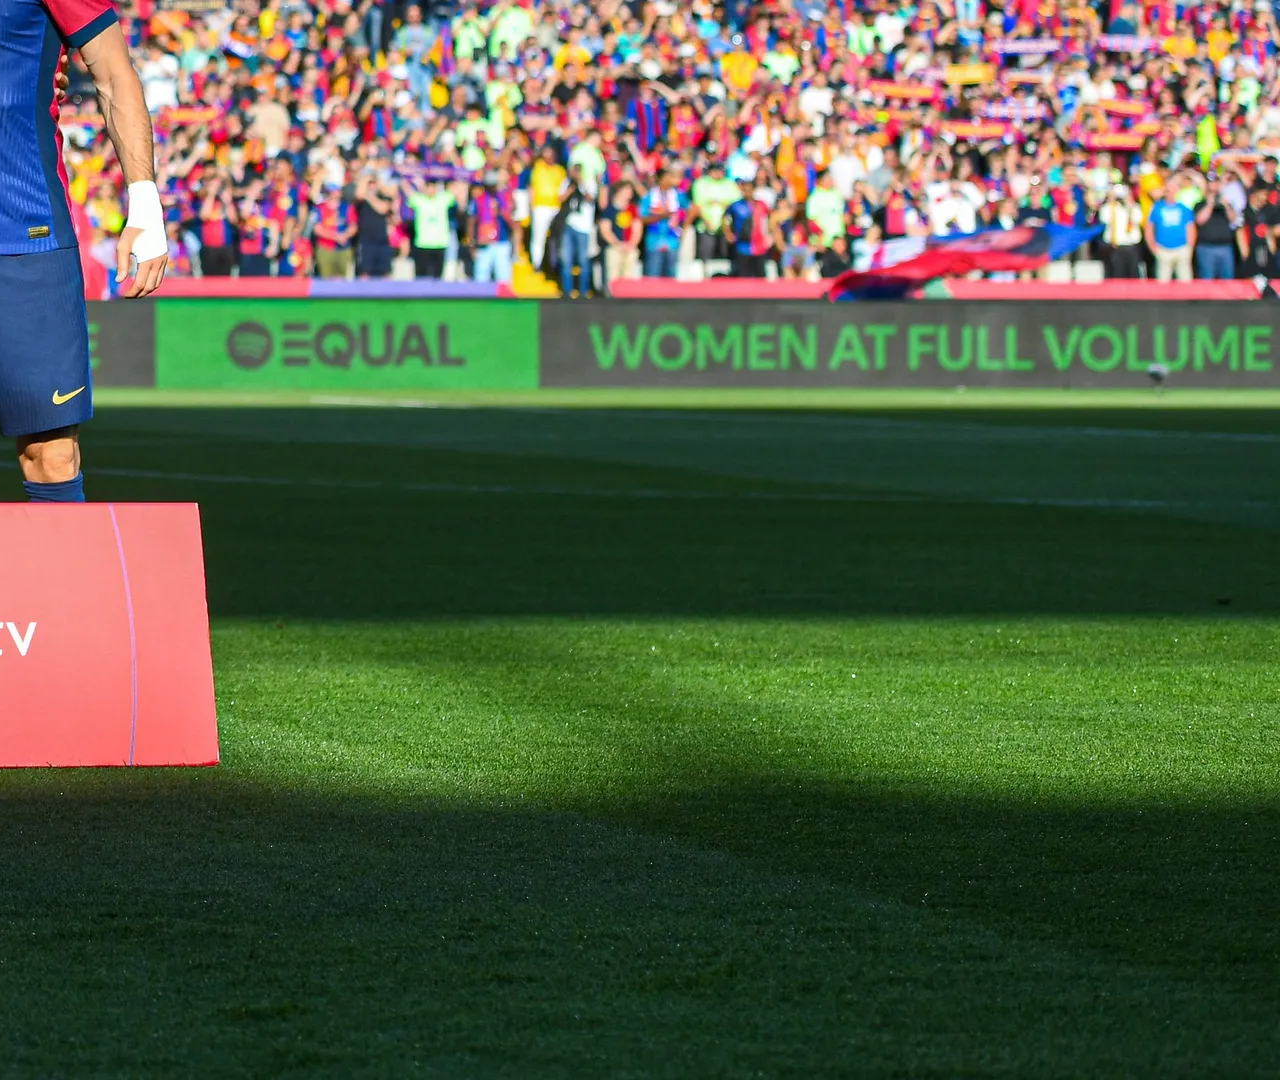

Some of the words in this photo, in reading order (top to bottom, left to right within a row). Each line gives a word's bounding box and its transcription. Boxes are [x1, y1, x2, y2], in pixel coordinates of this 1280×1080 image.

[282, 321, 468, 369] EQUAL
[588, 322, 819, 372] WOMEN
[827, 323, 898, 373] AT
[906, 323, 1036, 373] FULL
[1042, 324, 1274, 374] VOLUME
